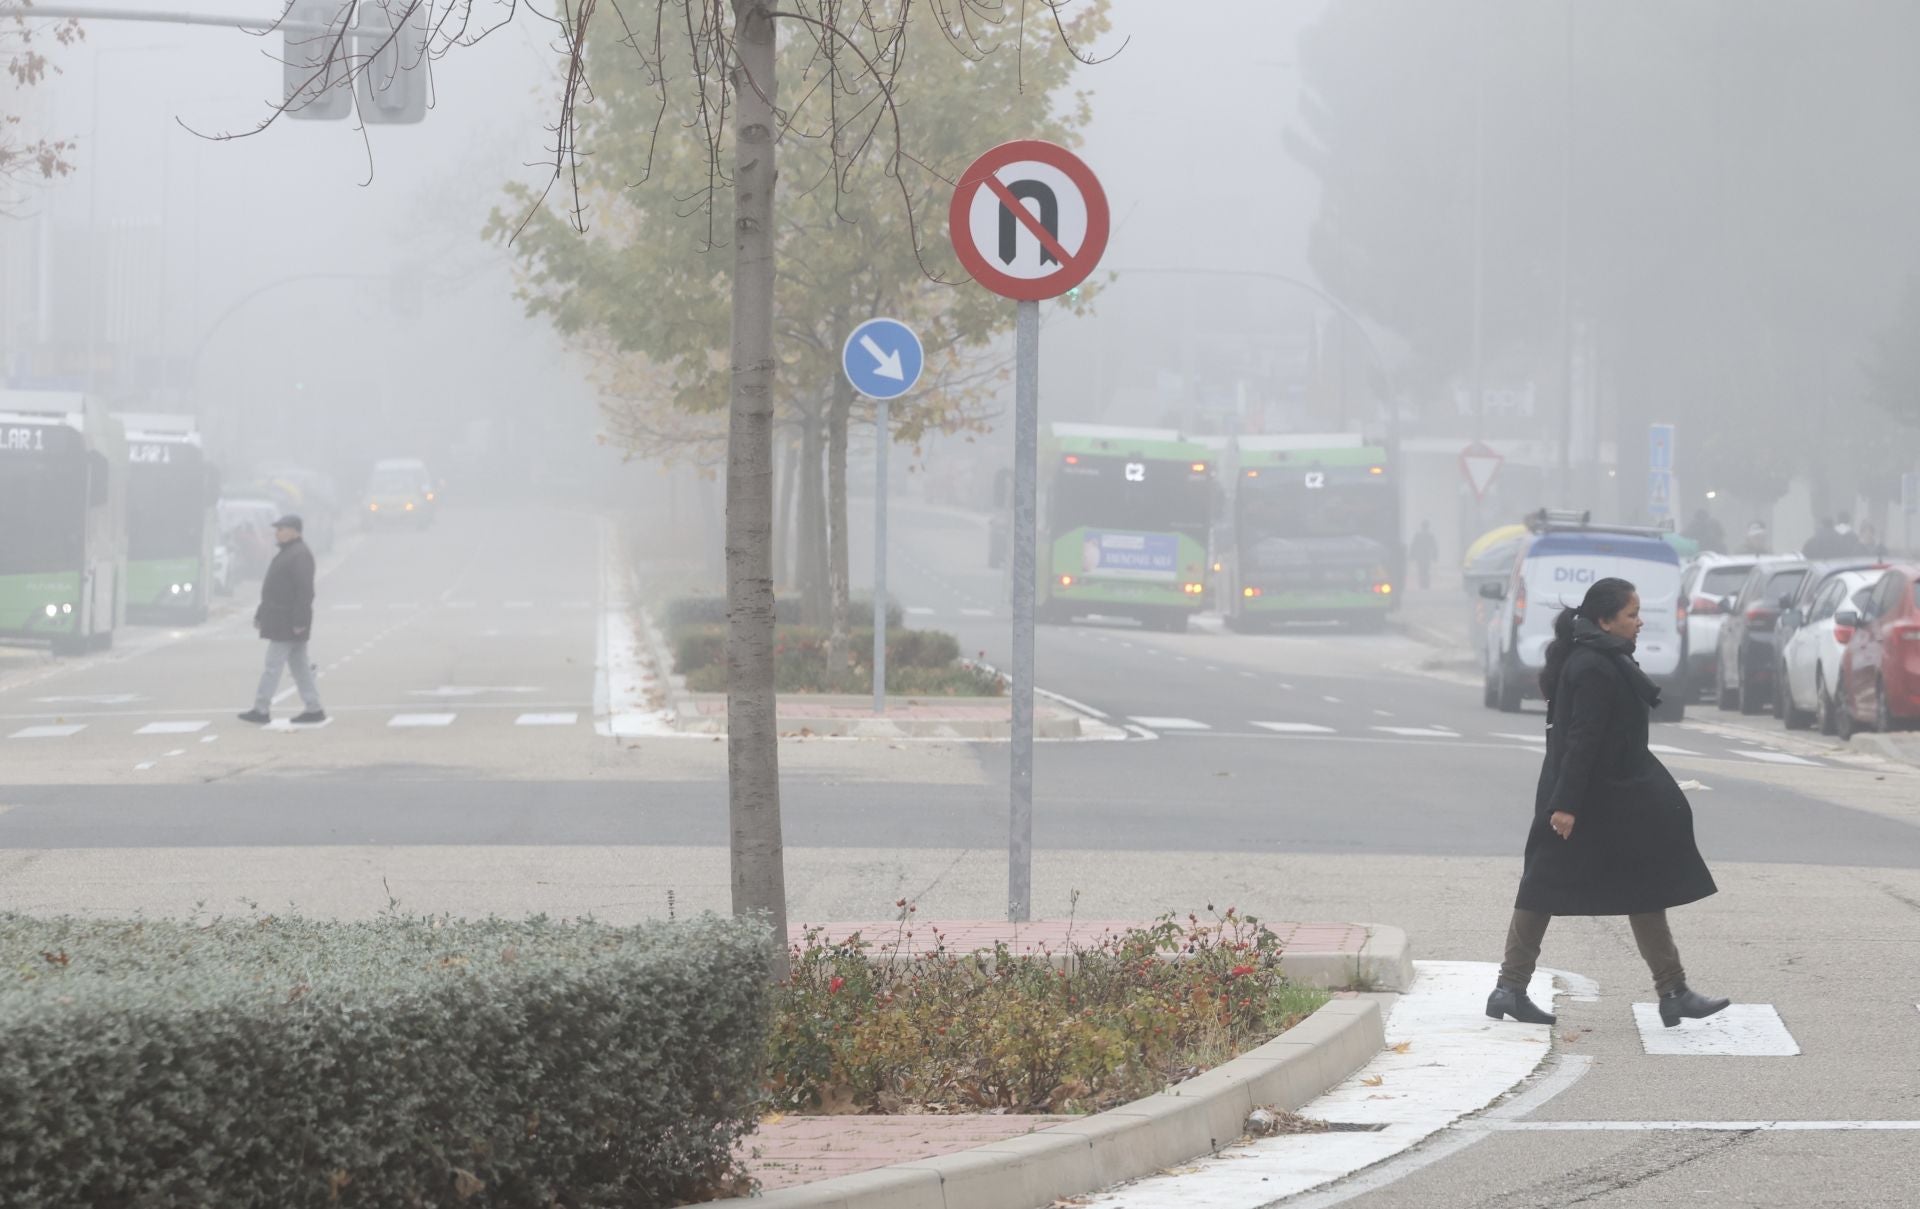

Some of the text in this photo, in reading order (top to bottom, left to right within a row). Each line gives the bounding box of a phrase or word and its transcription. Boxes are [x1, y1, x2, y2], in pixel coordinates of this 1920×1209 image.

[0, 428, 43, 450] LAR 1
[1125, 463, 1146, 482] C2
[1305, 472, 1325, 489] C2
[1554, 568, 1596, 583] DIGI
